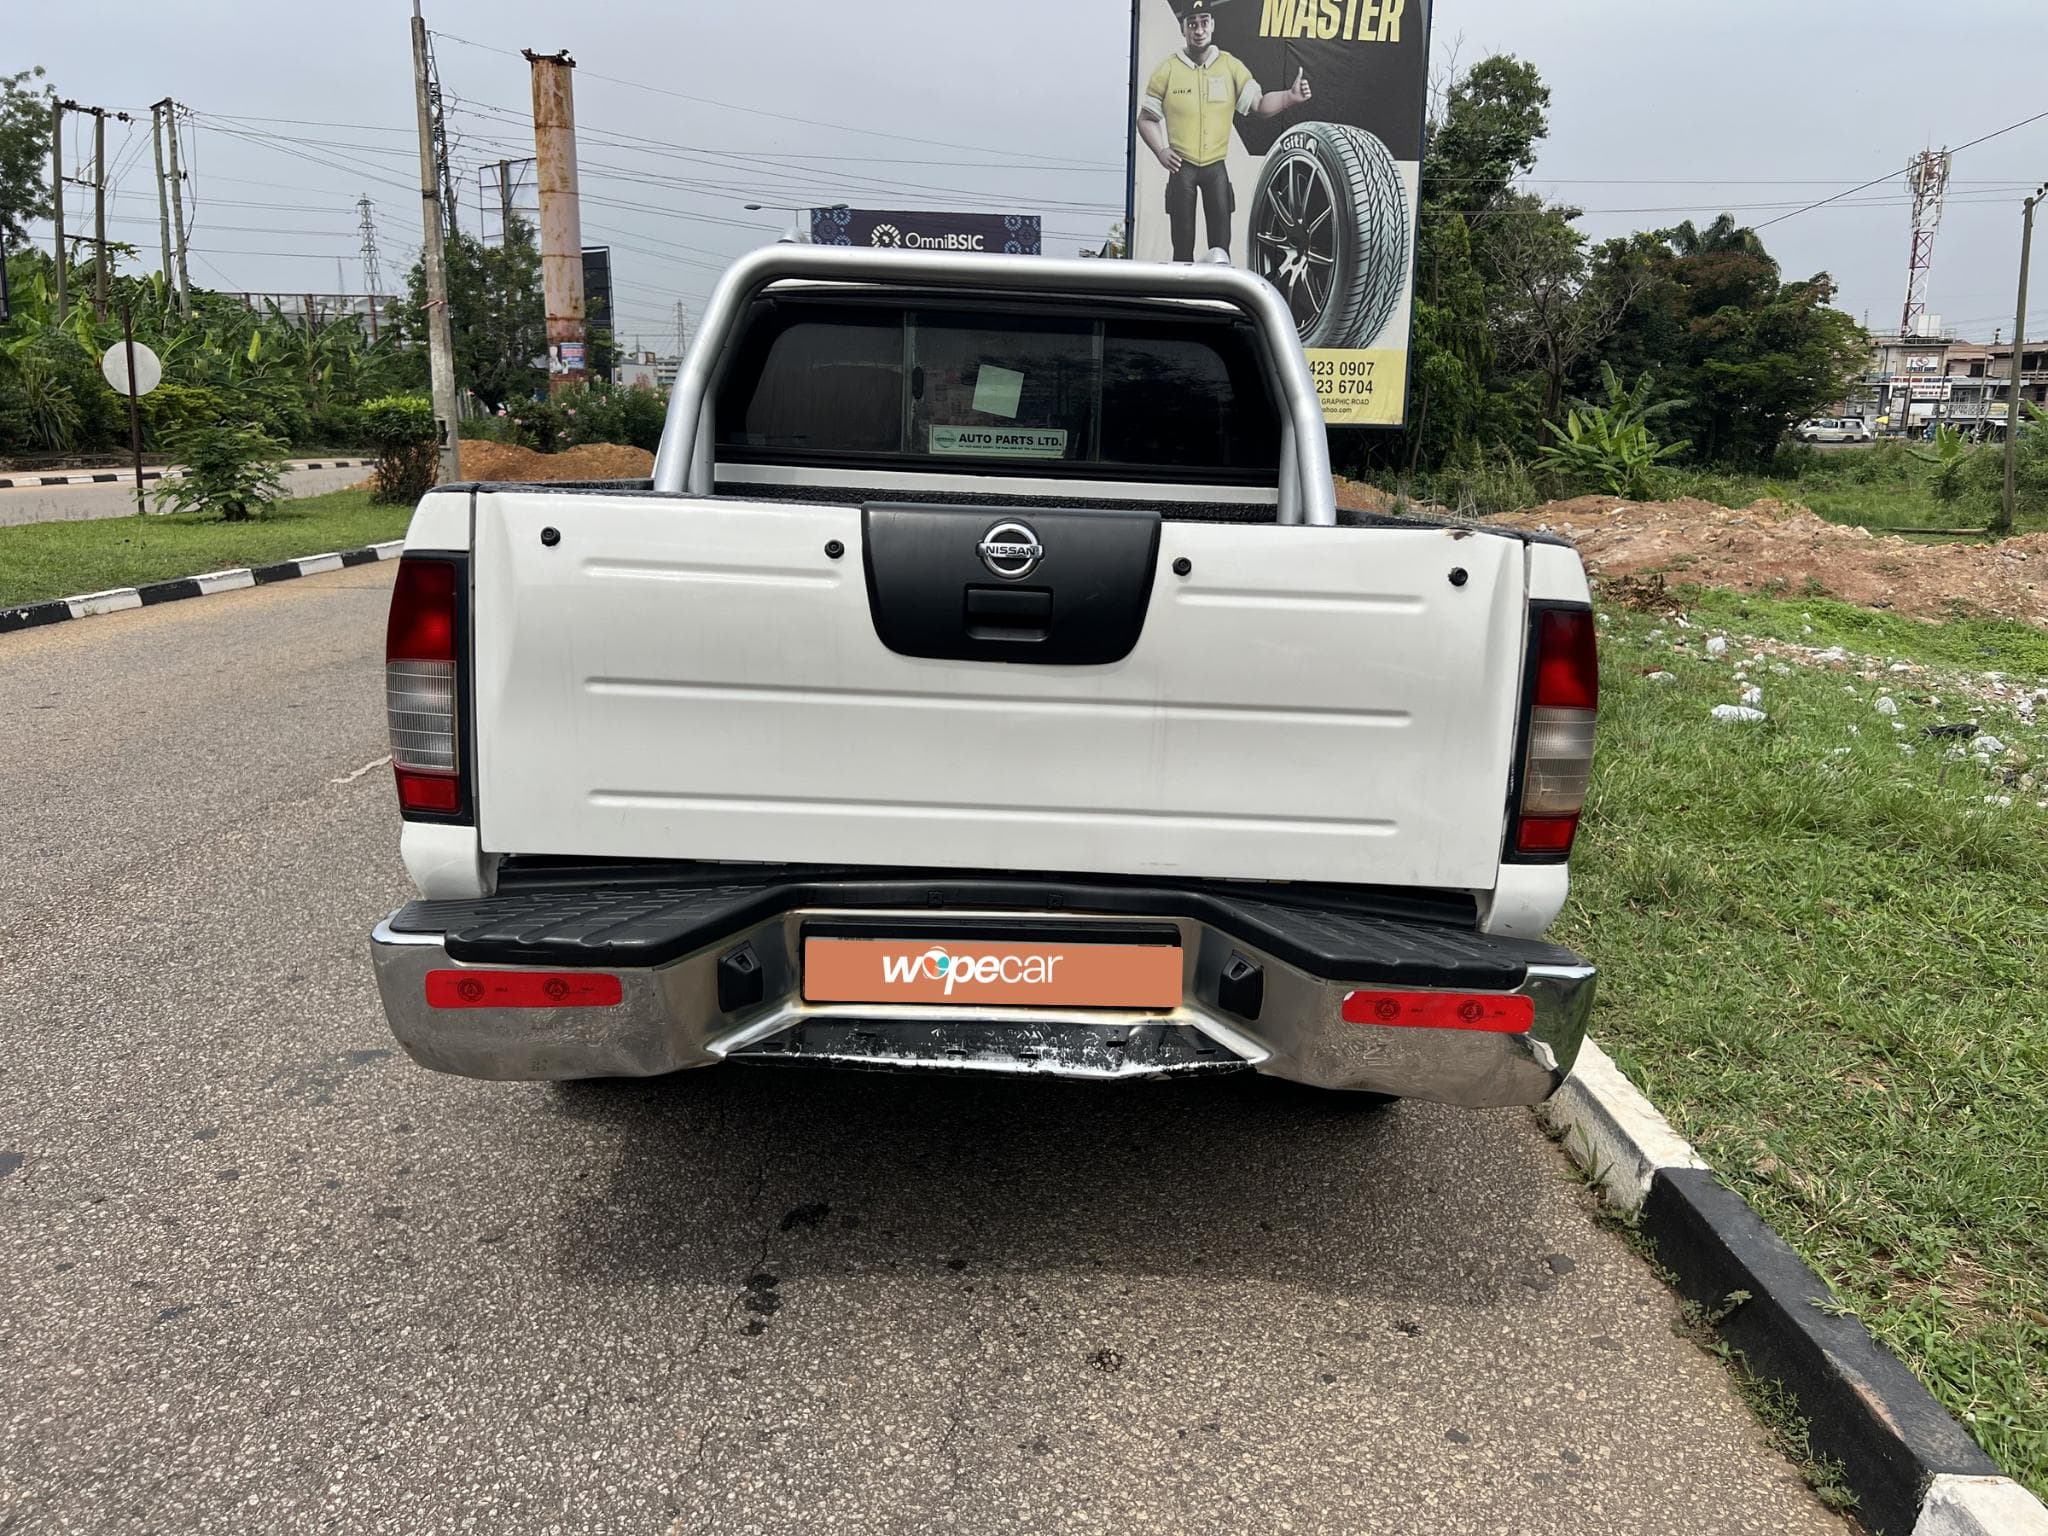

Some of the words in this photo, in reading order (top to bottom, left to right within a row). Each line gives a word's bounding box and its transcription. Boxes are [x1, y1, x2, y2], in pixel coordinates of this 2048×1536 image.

[1259, 0, 1405, 42] MASTER
[905, 232, 984, 250] OmniBSIC
[1309, 360, 1334, 375] 423
[1339, 361, 1375, 376] 0907
[1313, 379, 1334, 394] 23
[1338, 380, 1373, 394] 6704
[1321, 398, 1350, 406] GRAPHIC
[1351, 398, 1370, 406] ROAD
[959, 433, 992, 444] AUTO
[995, 434, 1034, 446] PARTS
[1037, 436, 1062, 447] LTD.
[985, 545, 1036, 556] NISSAN
